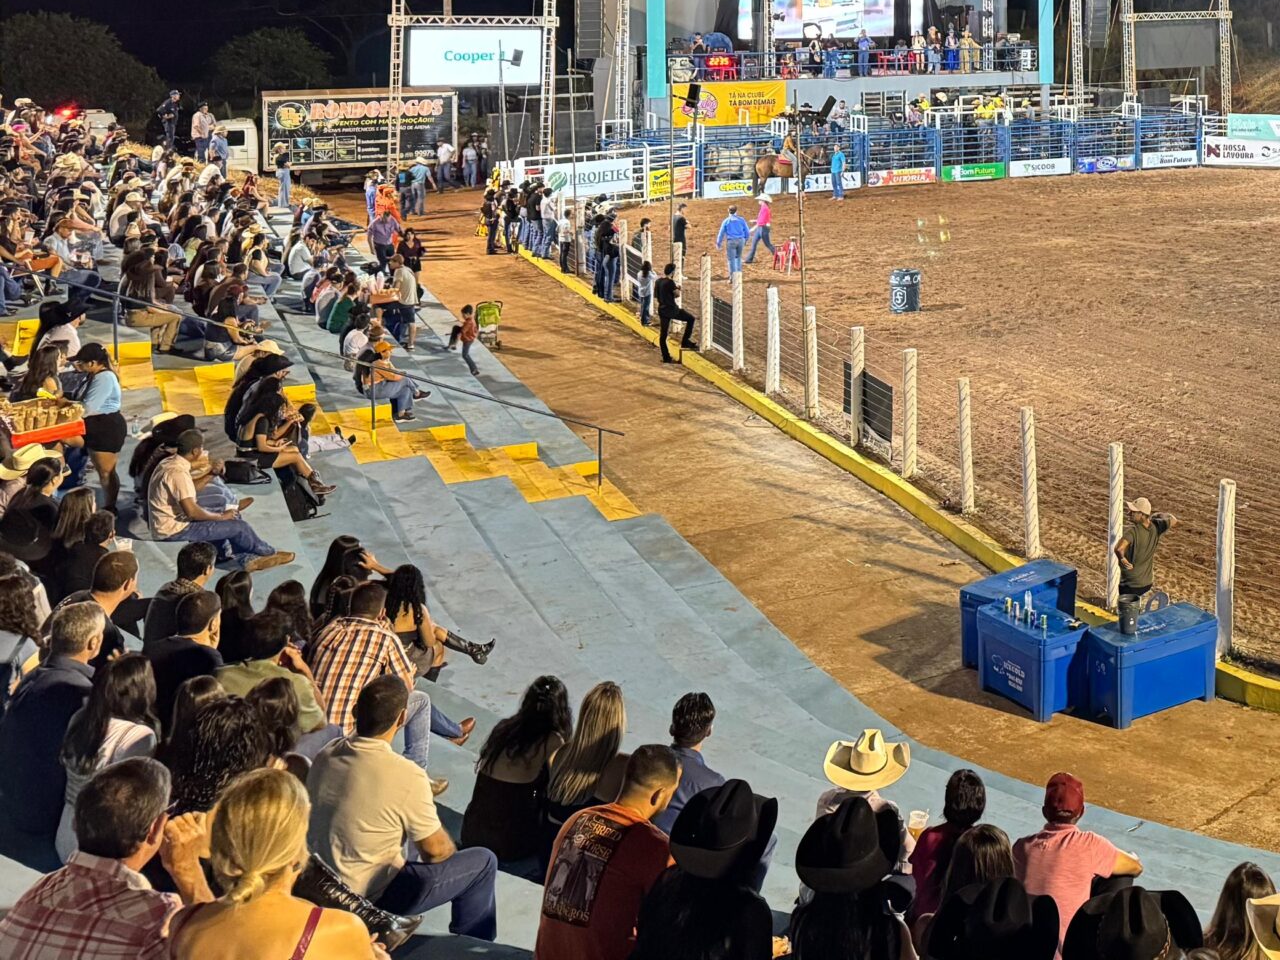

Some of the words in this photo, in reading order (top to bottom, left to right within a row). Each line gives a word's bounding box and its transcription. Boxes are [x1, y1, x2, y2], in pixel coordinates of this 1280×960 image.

[444, 50, 495, 64] Cooper
[753, 98, 776, 106] DEMAIS
[1031, 163, 1056, 171] SICOOB
[569, 168, 630, 185] PROJETEC
